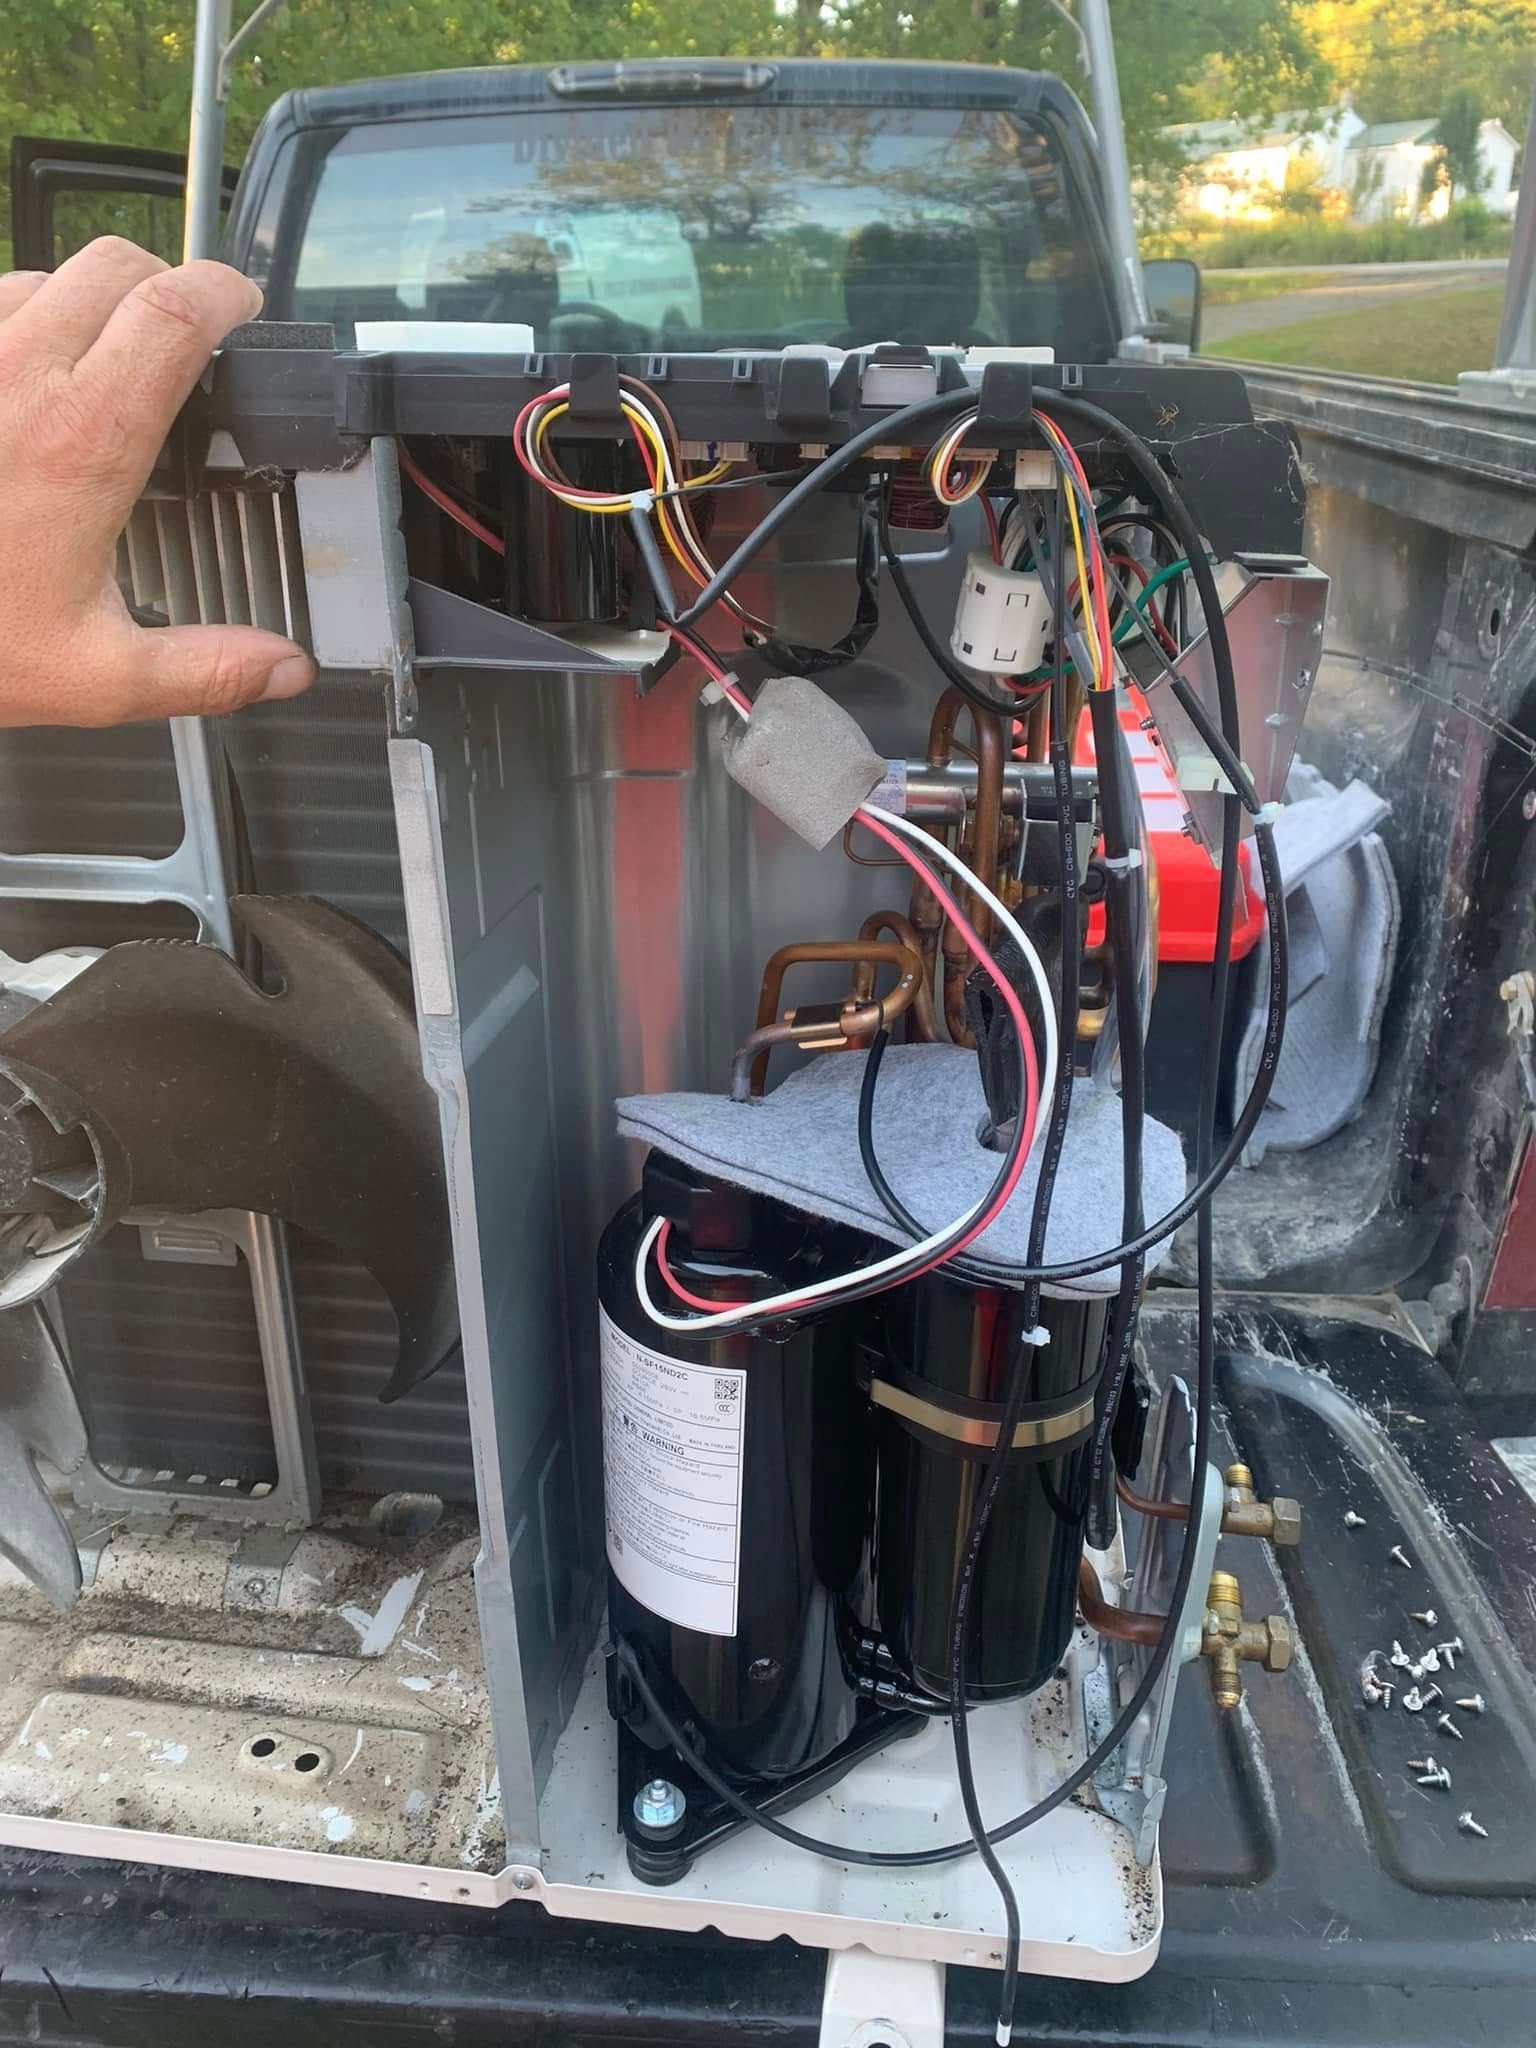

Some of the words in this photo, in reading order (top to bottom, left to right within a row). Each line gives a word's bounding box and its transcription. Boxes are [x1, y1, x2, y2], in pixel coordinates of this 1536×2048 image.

[1058, 759, 1069, 797] TUBING
[1062, 804, 1071, 825] PVC
[1064, 833, 1074, 871] CB-600
[1272, 940, 1281, 975] TUBING
[1272, 983, 1281, 1002] PVC
[636, 1353, 689, 1381] N-SF15ND2C
[642, 1430, 685, 1456] WARNING
[954, 1622, 963, 1651] TUBING
[952, 1656, 960, 1673] PVC
